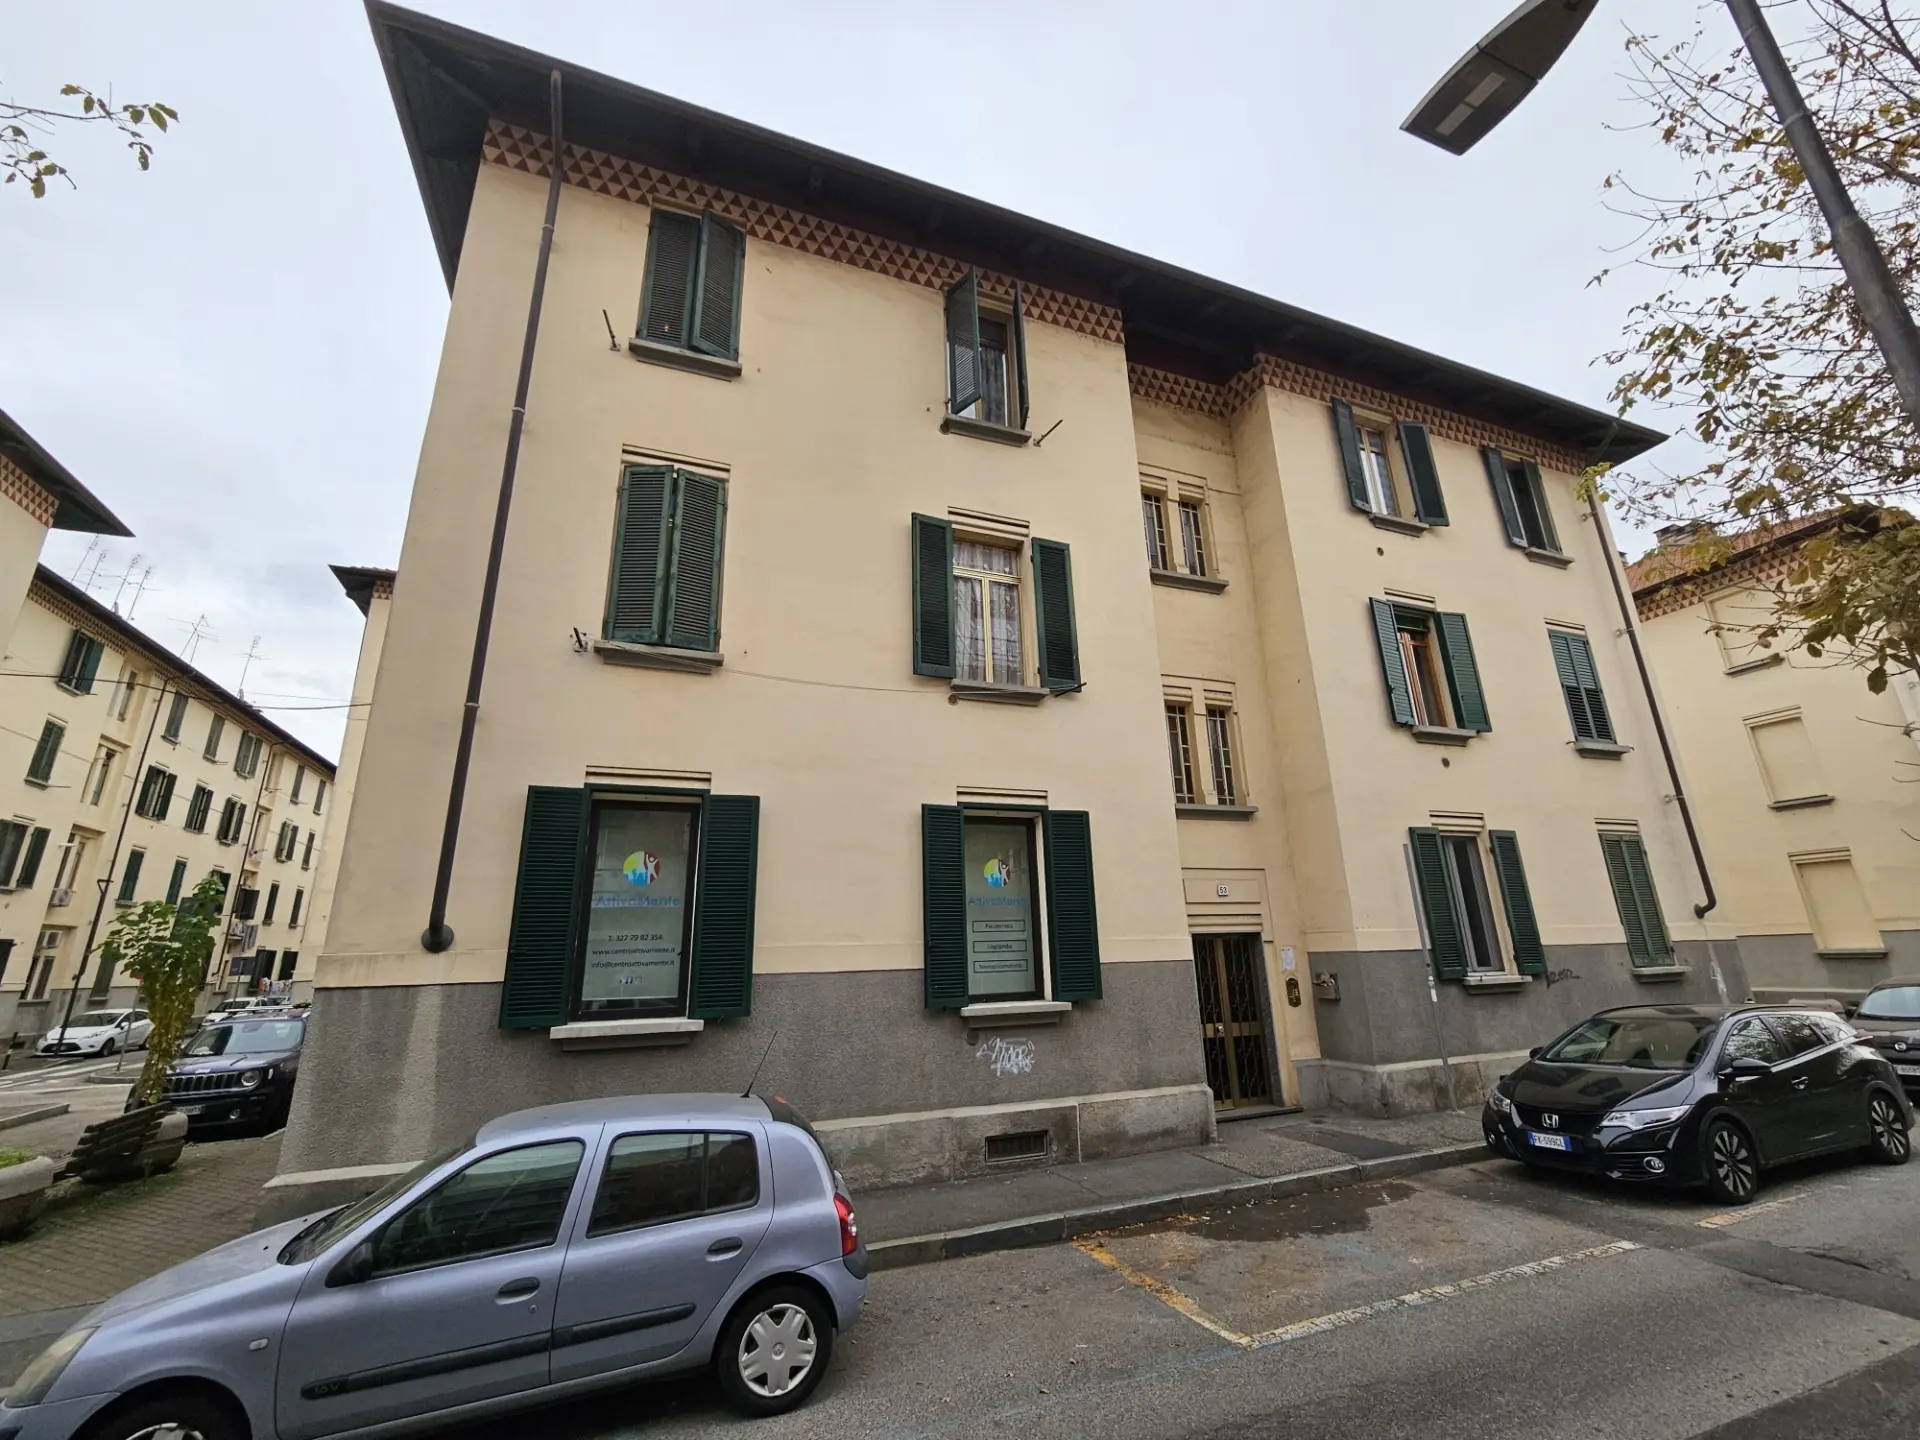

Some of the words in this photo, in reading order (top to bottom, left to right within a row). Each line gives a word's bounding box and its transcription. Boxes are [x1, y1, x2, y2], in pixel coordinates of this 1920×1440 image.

[1219, 886, 1228, 894] 53
[596, 895, 680, 906] AttivaMente
[616, 934, 628, 942] 327
[630, 934, 639, 942] 79
[640, 933, 649, 941] 82
[650, 933, 663, 941] 354
[592, 947, 676, 955] www.centroattivamente.it
[591, 959, 675, 969] info@centroattivamente.it
